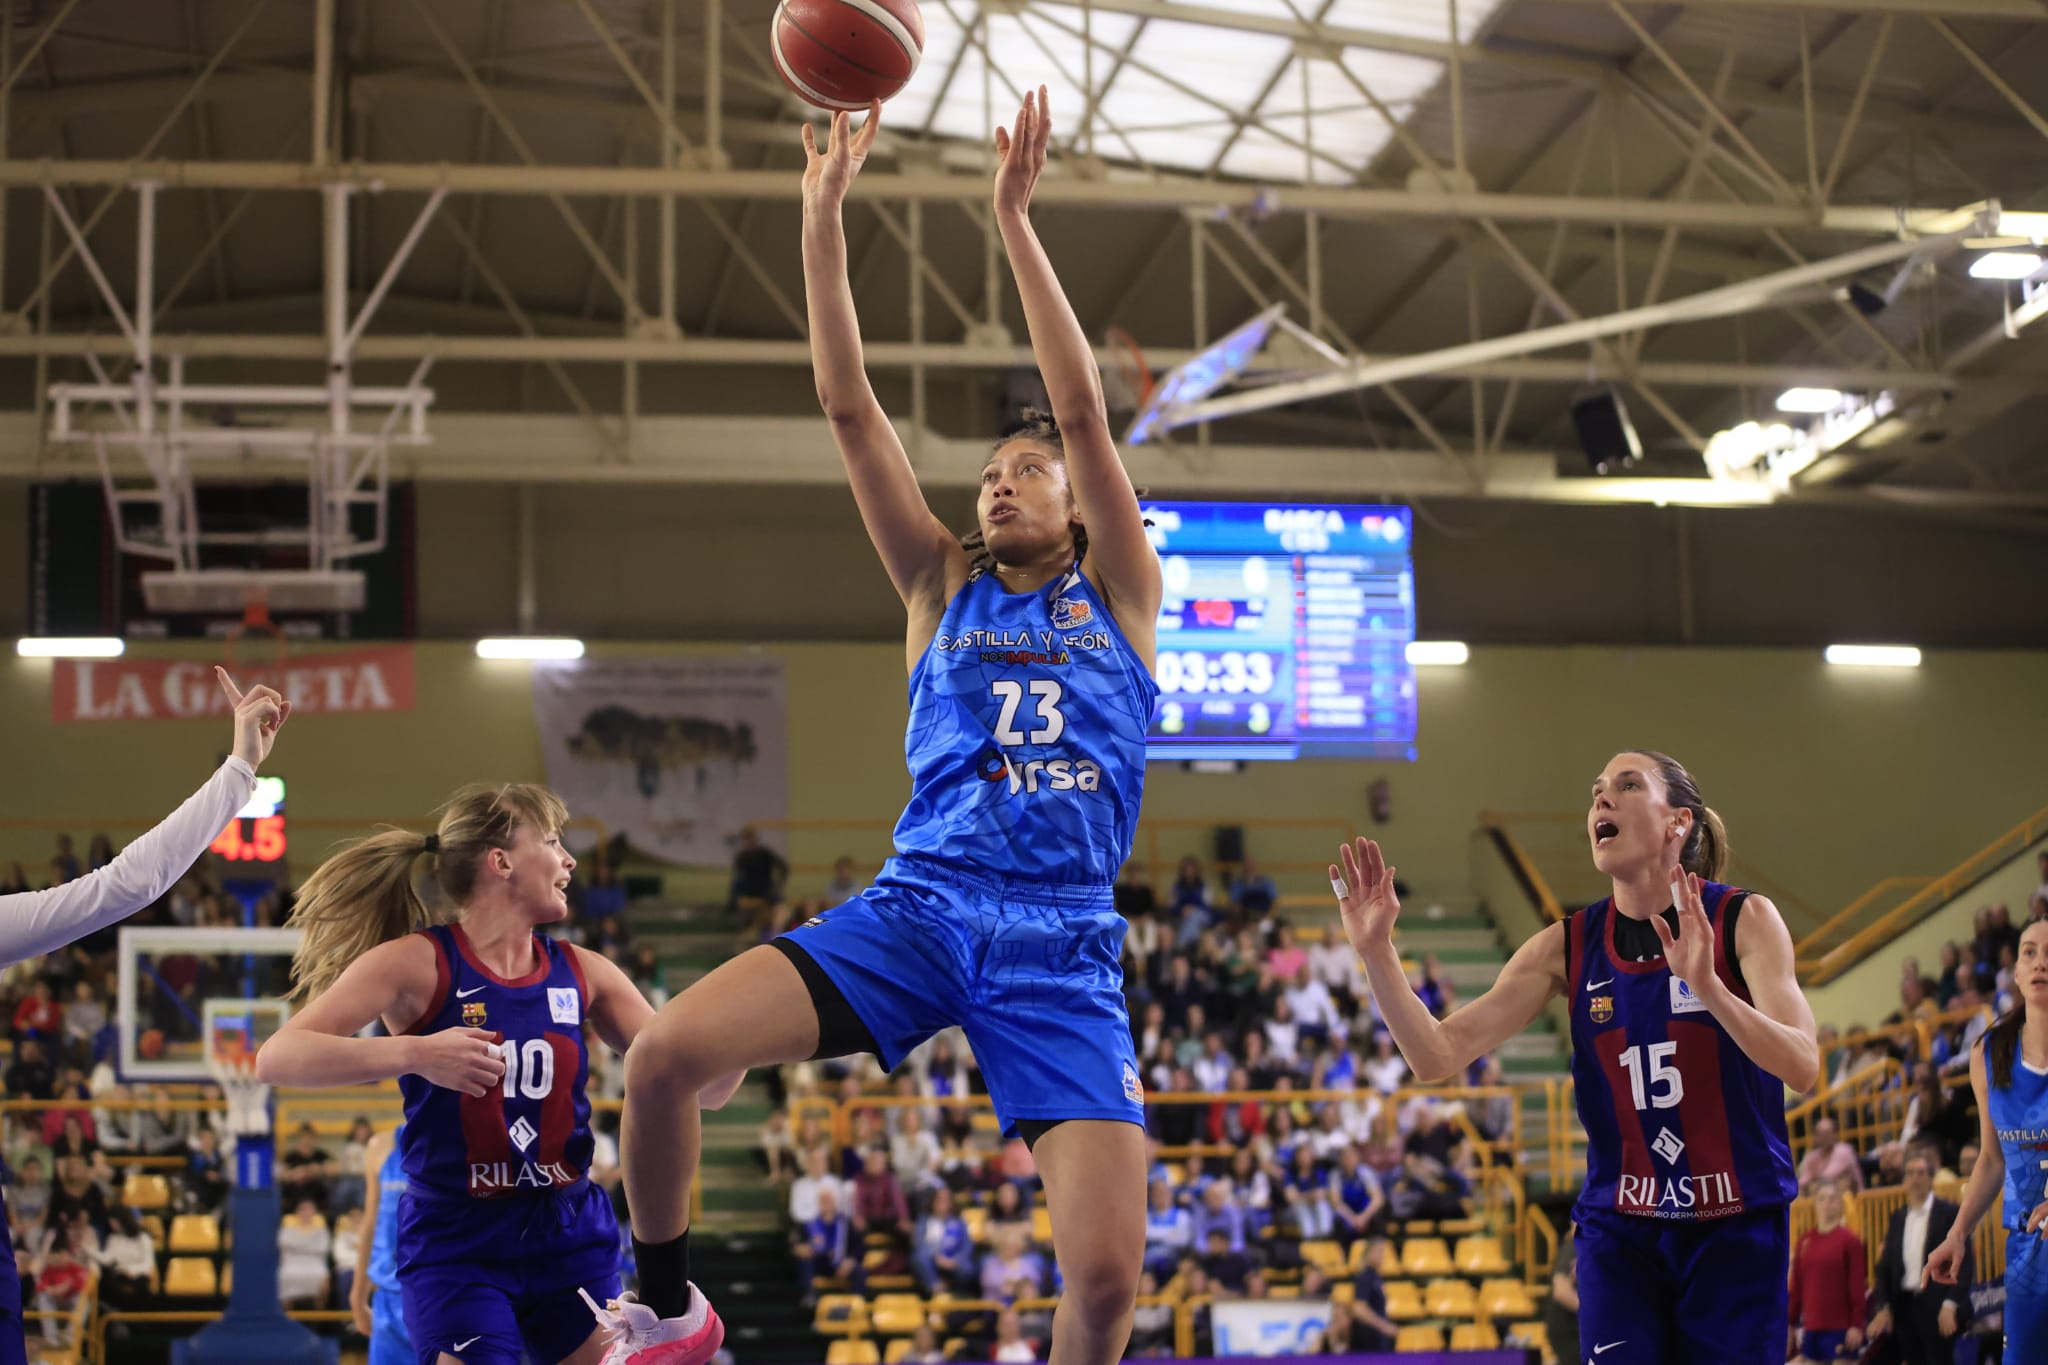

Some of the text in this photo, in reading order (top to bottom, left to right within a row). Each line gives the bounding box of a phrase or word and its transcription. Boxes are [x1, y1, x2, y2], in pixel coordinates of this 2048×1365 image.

[937, 630, 1031, 651] CASTILLA
[1040, 631, 1053, 651] Y
[981, 651, 1069, 665] NOS IMPULSA
[1156, 651, 1273, 694] 03:33
[991, 679, 1065, 747] 23
[501, 1038, 554, 1100] 10
[1618, 1040, 1684, 1110] 15
[1618, 1172, 1740, 1208] RILASTIL
[1670, 1205, 1742, 1220] DERMATOLOGICO
